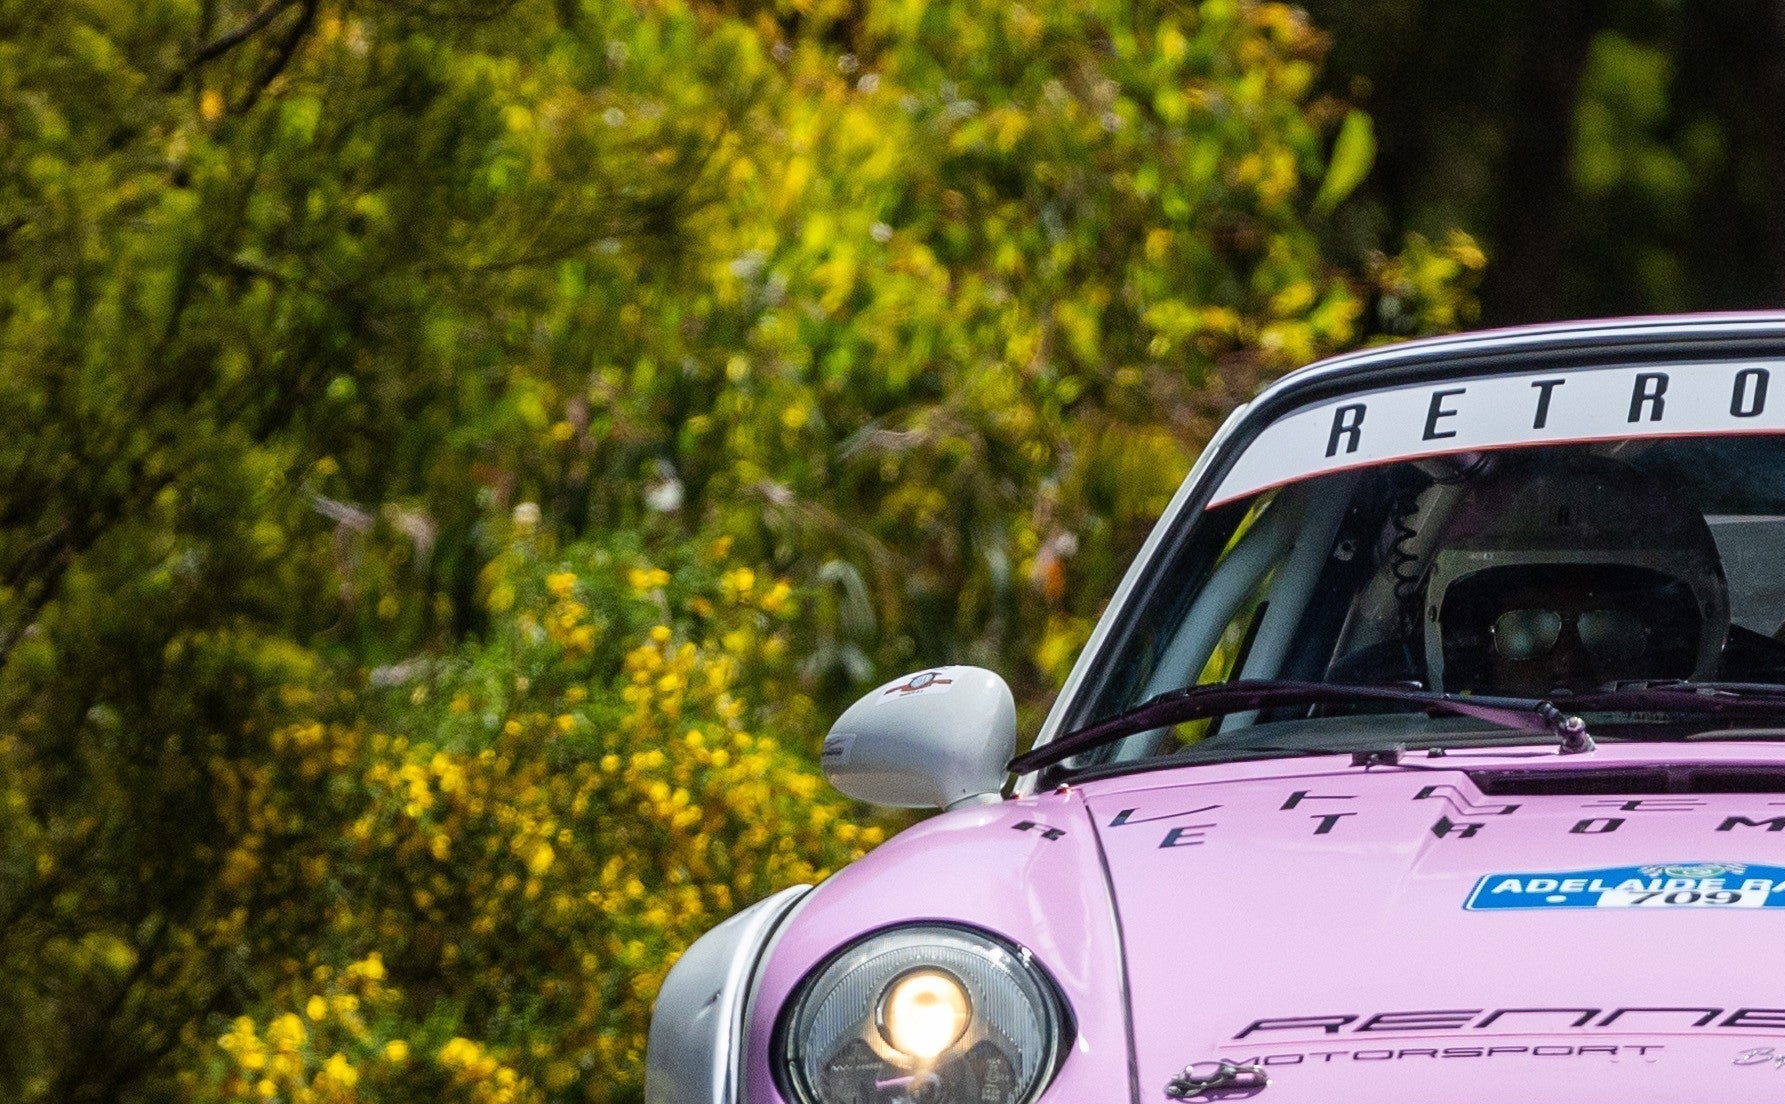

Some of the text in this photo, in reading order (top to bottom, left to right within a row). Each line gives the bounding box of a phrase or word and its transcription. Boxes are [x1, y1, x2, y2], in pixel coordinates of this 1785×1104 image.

[1491, 876, 1728, 894] ADELAIDE
[1630, 890, 1742, 905] 709
[1219, 1045, 1665, 1067] MOTORSPORT
